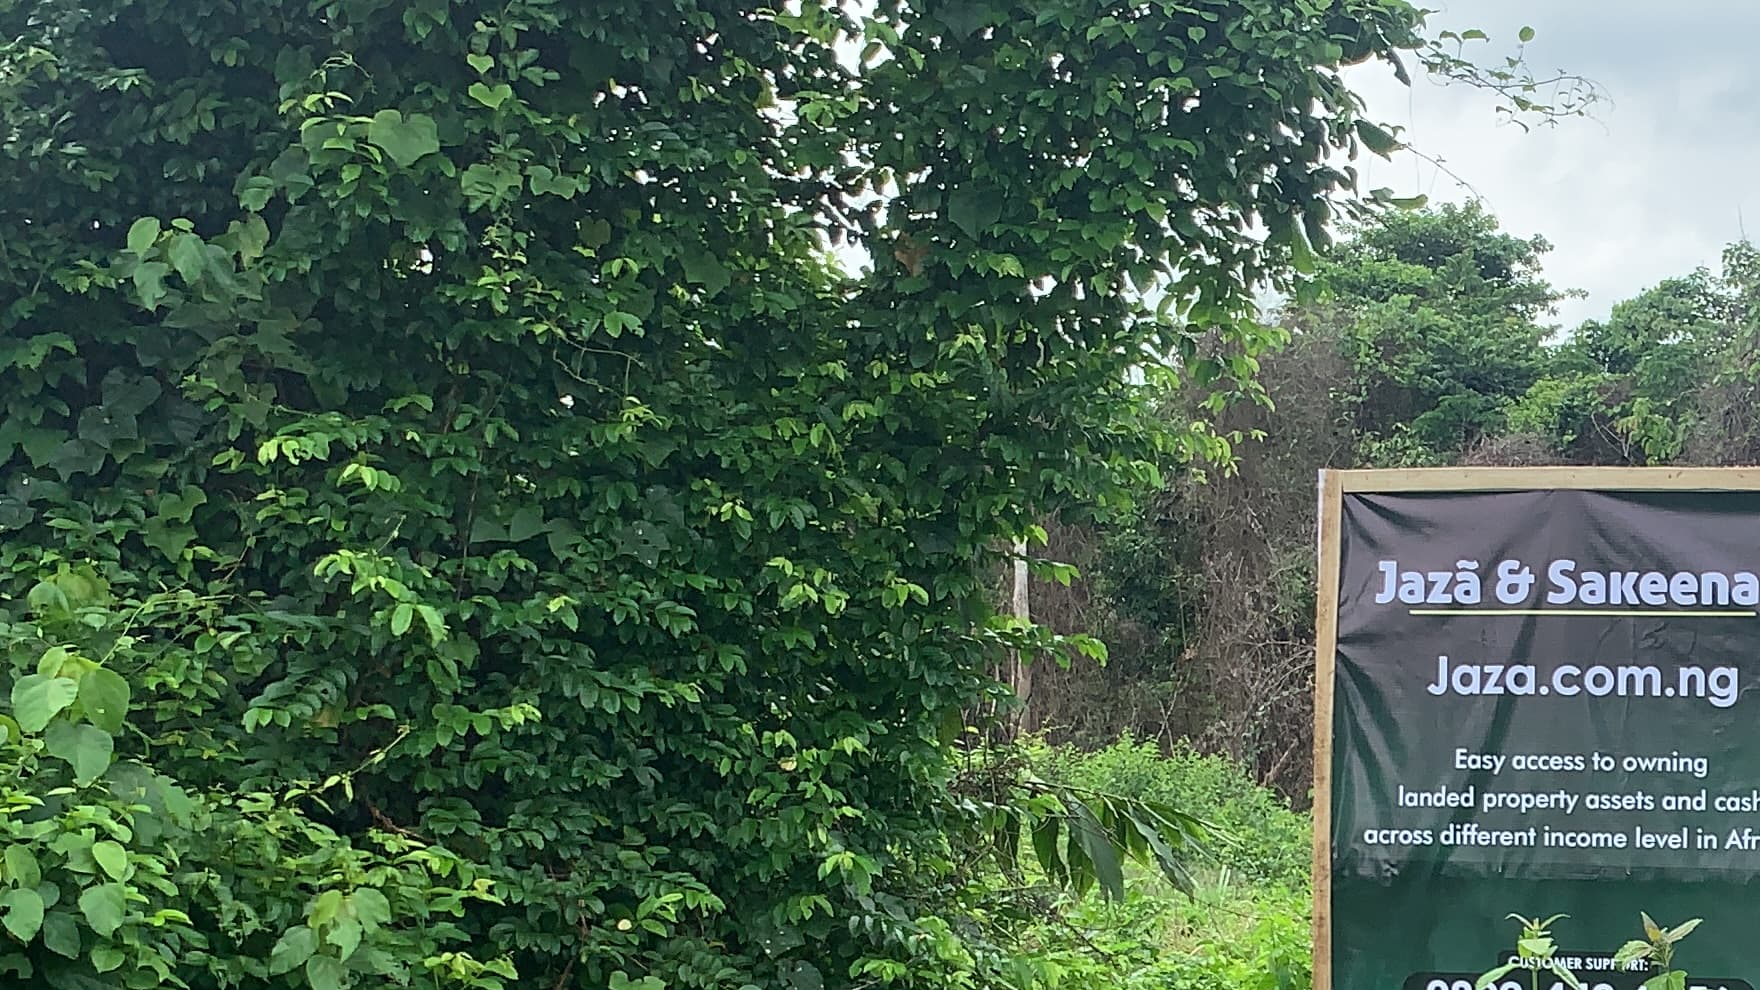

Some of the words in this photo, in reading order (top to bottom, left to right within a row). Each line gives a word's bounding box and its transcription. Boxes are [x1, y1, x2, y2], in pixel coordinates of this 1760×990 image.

[1496, 559, 1536, 605] &
[1427, 655, 1740, 709] Jaza.com.ng
[1455, 748, 1506, 775] Easy
[1511, 755, 1585, 771] access
[1591, 751, 1616, 772] to
[1622, 751, 1708, 778] owning
[1398, 784, 1475, 807] landed
[1483, 789, 1579, 814] property
[1585, 790, 1655, 810] assets
[1662, 788, 1706, 811] and
[1363, 828, 1434, 845] across
[1439, 823, 1537, 847] different
[1543, 825, 1628, 848] income
[1635, 826, 1689, 849] level
[1696, 828, 1718, 850] in
[1507, 955, 1583, 970] CUSTOMER
[1585, 956, 1649, 972] SUPPRT:
